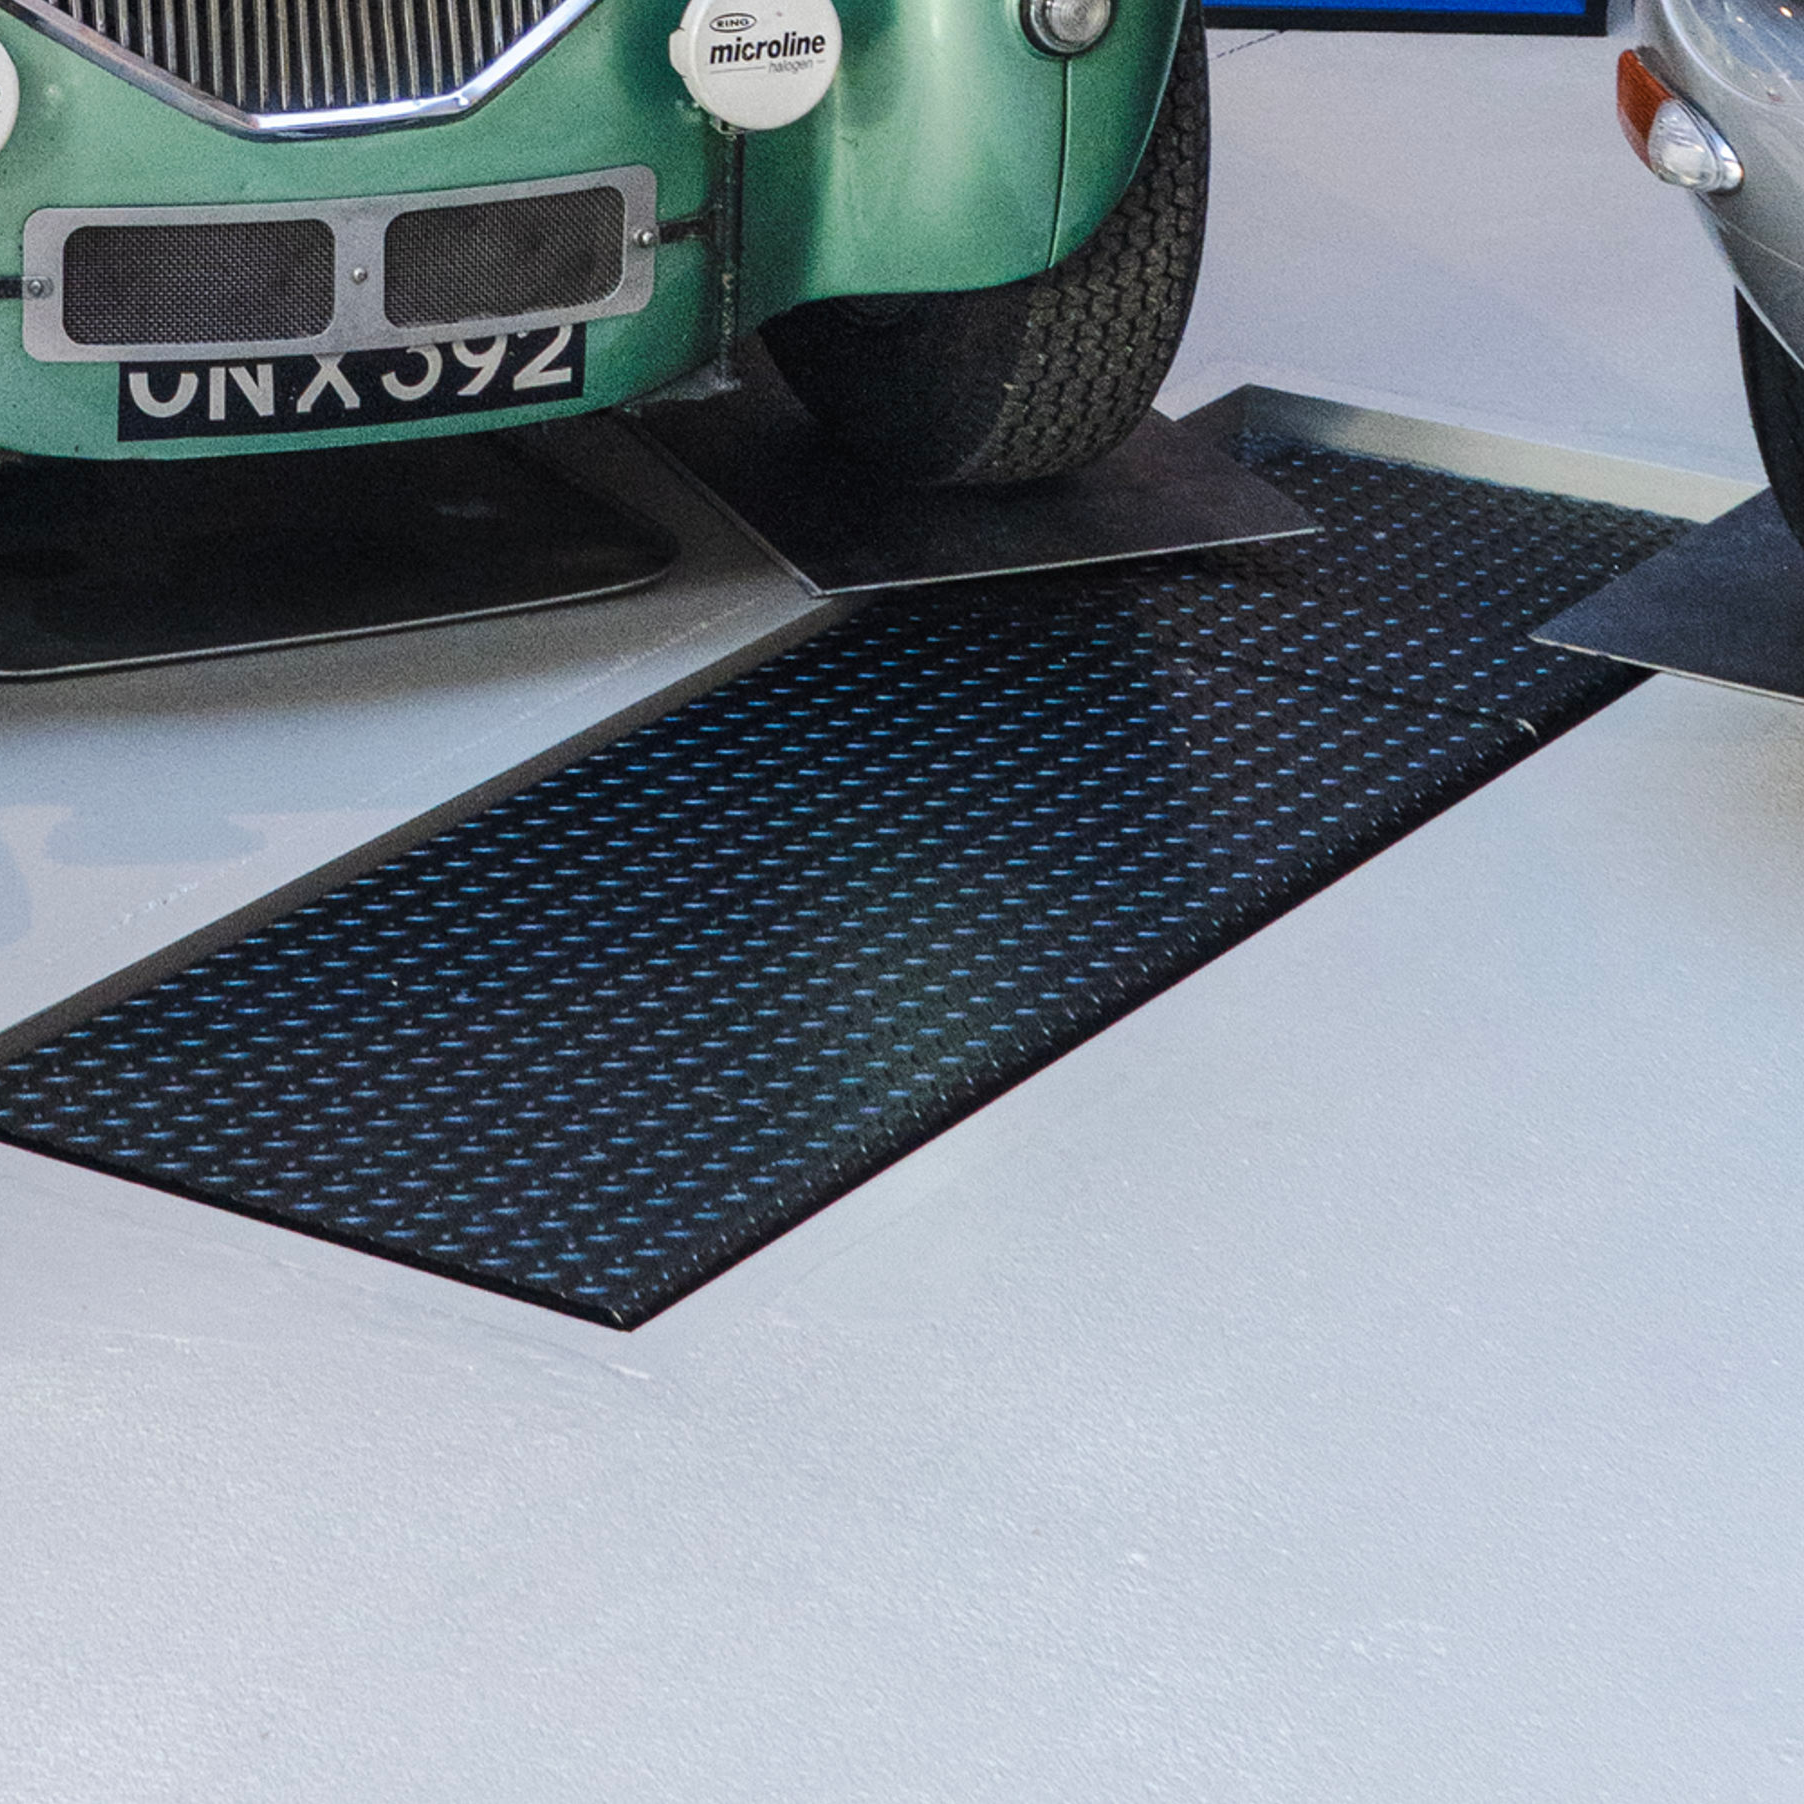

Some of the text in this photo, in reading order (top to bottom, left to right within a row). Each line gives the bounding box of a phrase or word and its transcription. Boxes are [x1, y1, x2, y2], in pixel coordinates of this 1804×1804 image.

[716, 18, 749, 29] RING
[709, 31, 827, 65] microline
[768, 59, 814, 75] halogen
